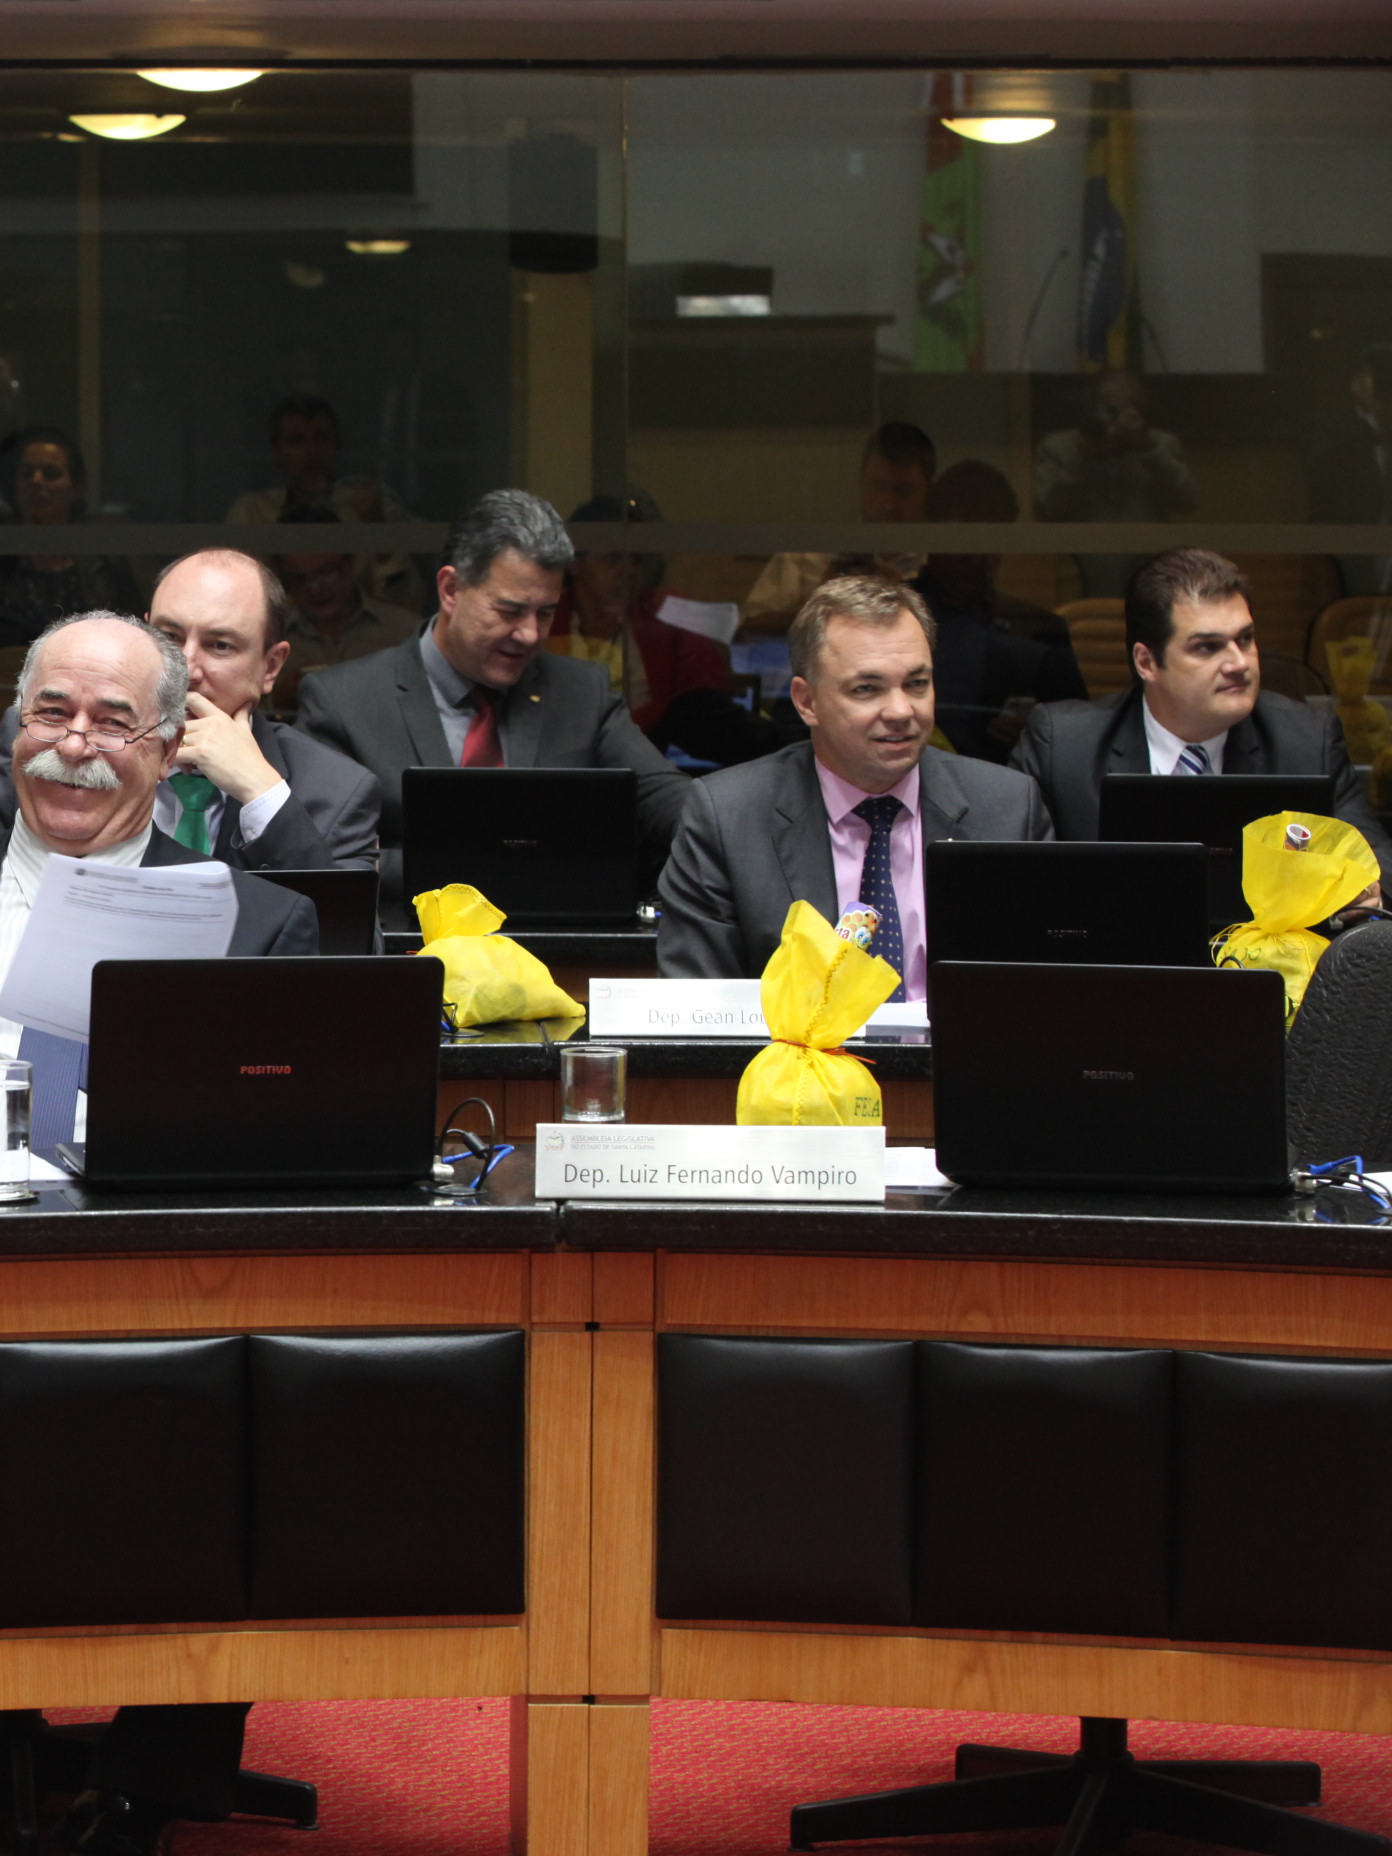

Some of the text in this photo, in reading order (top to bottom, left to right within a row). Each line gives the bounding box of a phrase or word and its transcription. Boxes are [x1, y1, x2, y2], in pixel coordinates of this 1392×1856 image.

[648, 1008, 766, 1027] Dep. Gean Lou
[240, 1065, 292, 1075] POSITIVO
[564, 1163, 858, 1190] Dep. Luiz Fernando Vampiro
